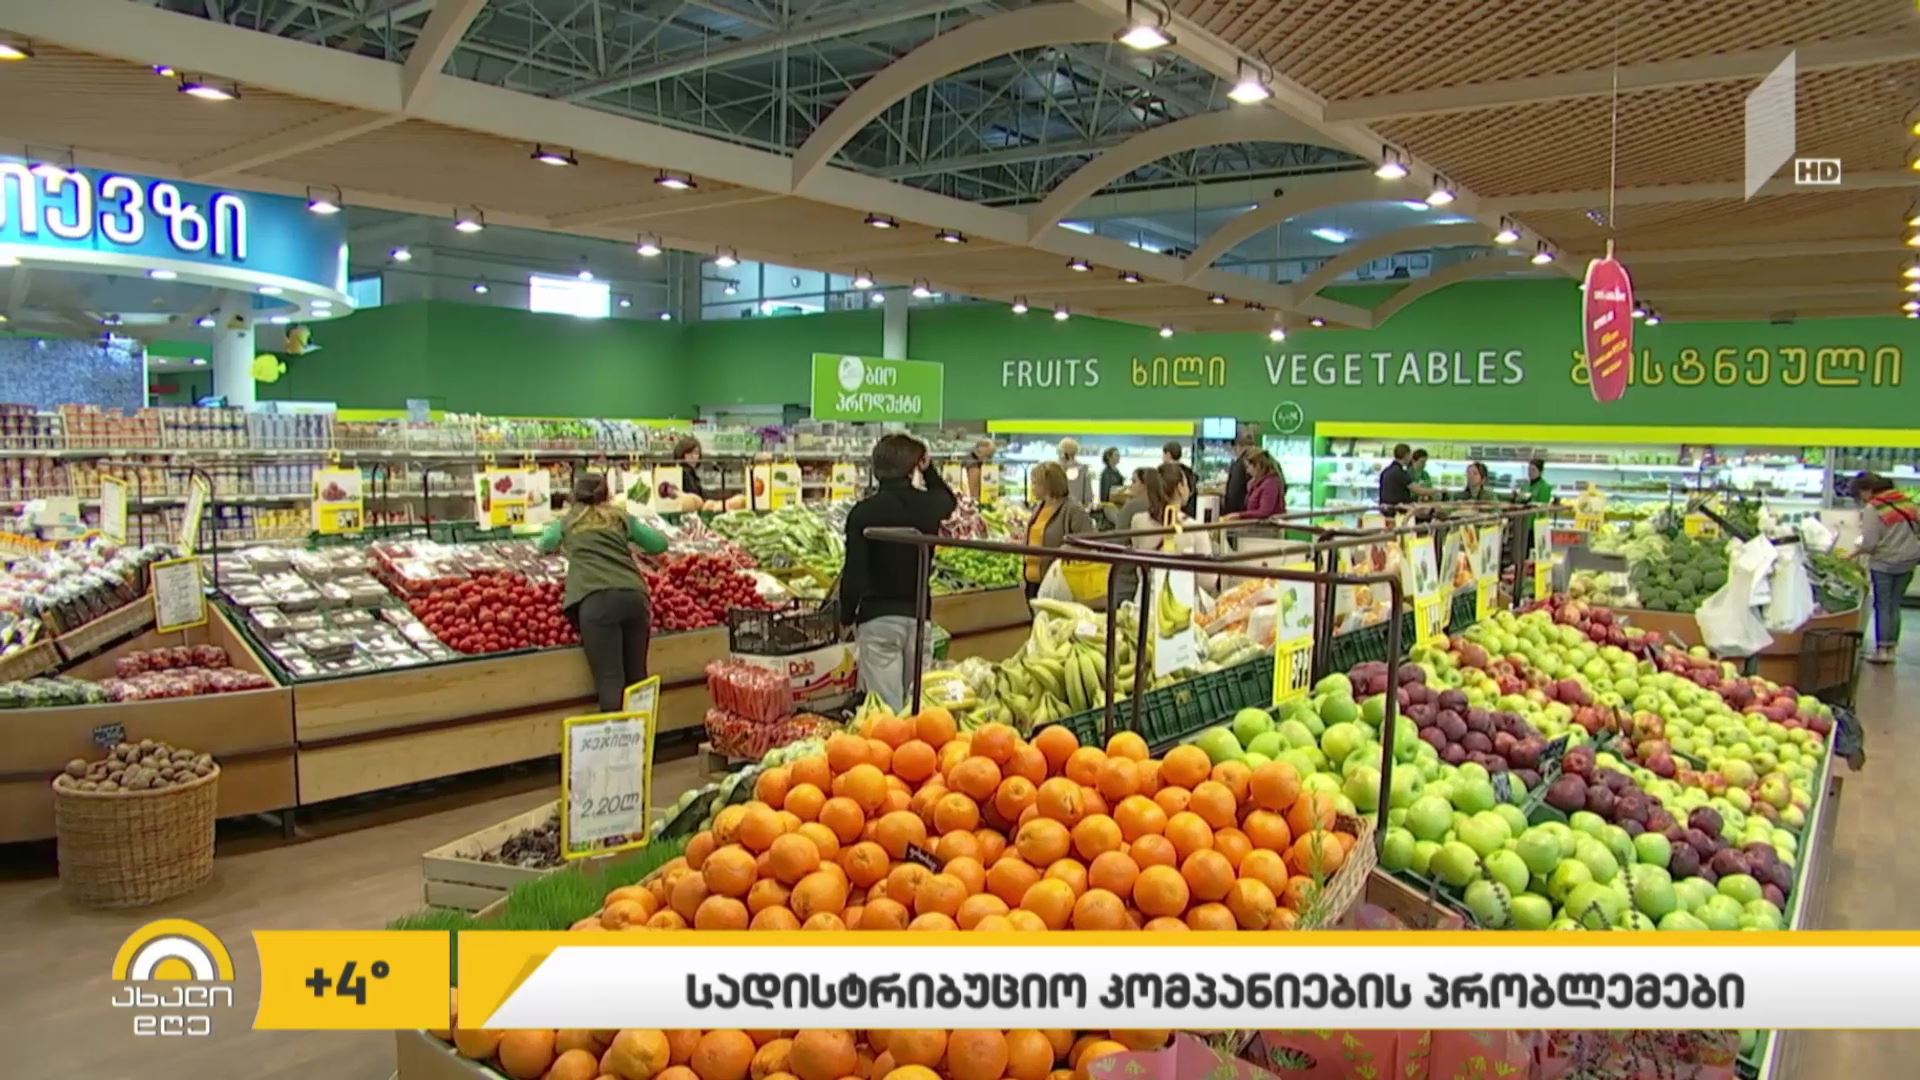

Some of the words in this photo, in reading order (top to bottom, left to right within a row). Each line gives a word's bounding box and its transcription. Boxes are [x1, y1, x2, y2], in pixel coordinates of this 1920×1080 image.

[1002, 358, 1099, 387] FRUITS
[1131, 355, 1226, 387] ხილი
[1264, 350, 1524, 386] VEGETABLES
[1571, 347, 1902, 387] ბსტნეული
